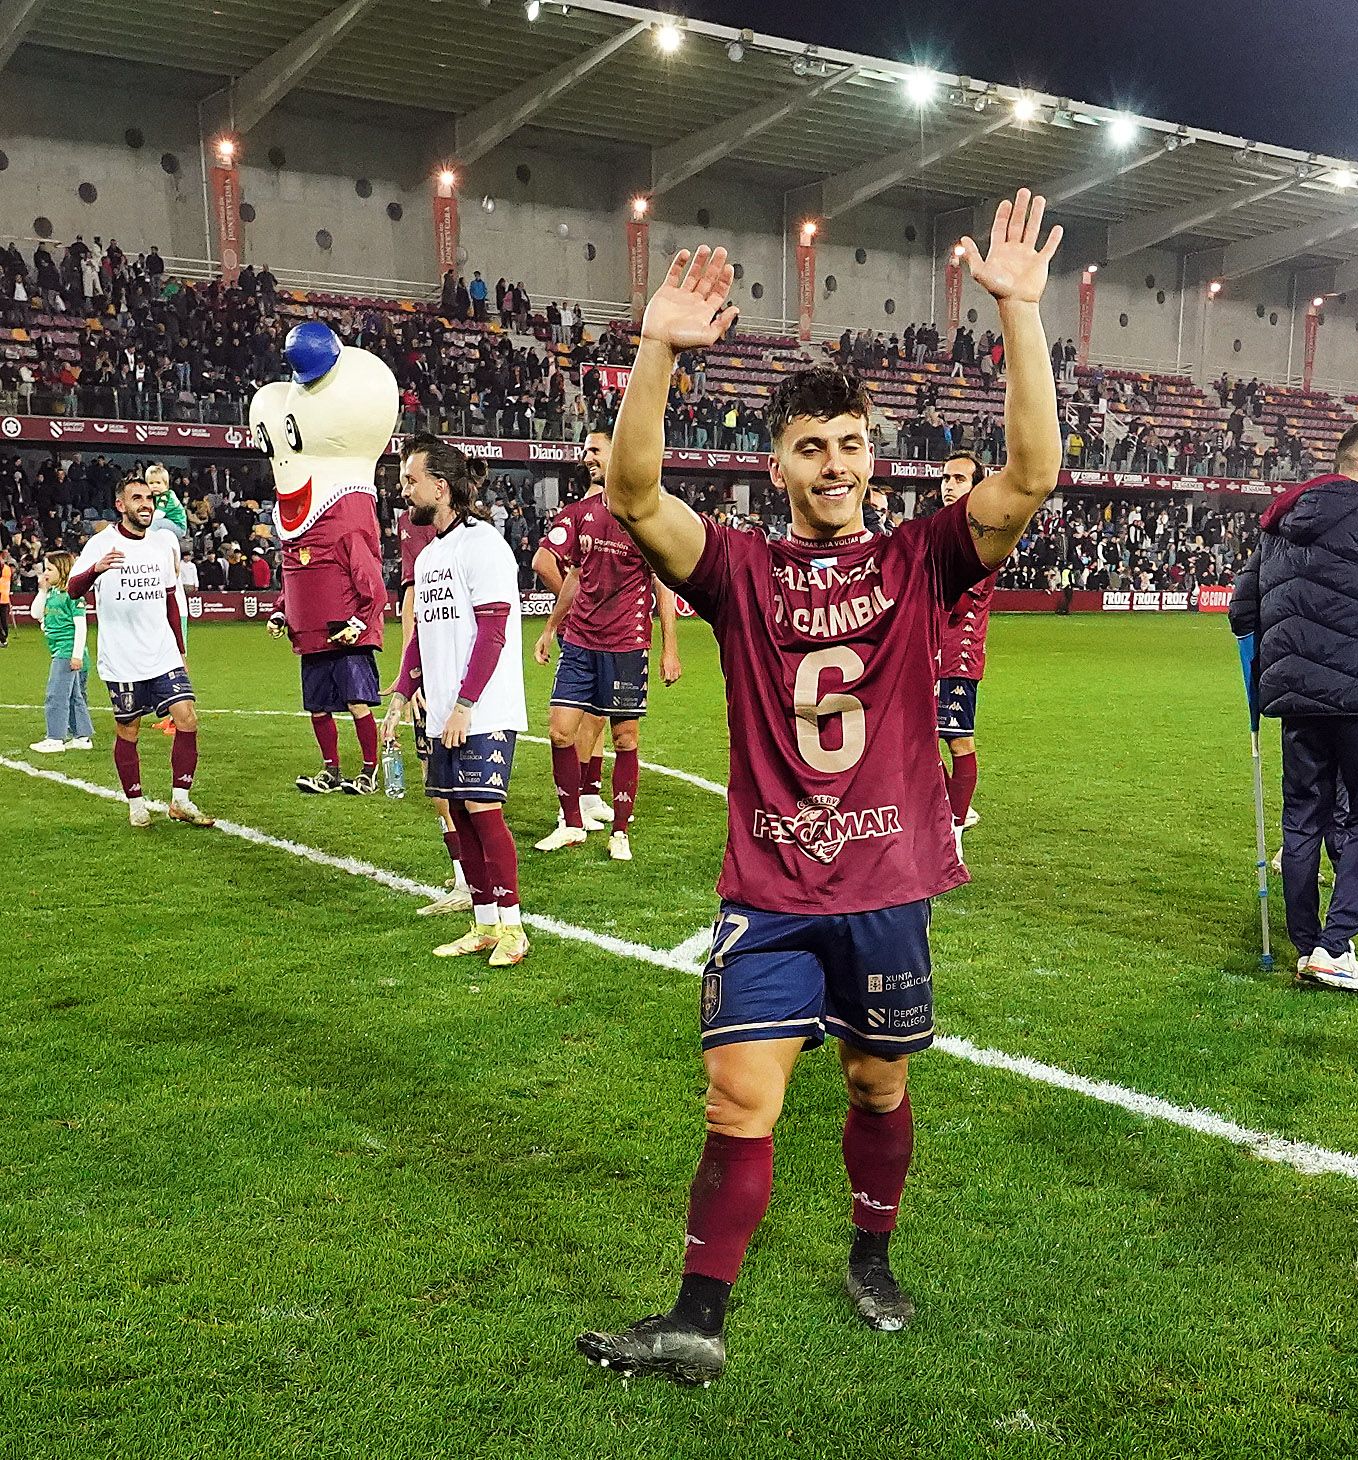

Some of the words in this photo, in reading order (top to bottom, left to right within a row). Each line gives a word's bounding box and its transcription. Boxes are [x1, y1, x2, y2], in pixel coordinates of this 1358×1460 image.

[529, 444, 563, 460] Diario
[120, 563, 161, 575] MUCHA
[116, 591, 126, 601] J.
[1102, 591, 1131, 605] FROIZ
[1133, 592, 1160, 605] FROIZ
[1161, 592, 1188, 605] FROIZ
[520, 600, 556, 615] ESCA
[792, 586, 895, 638] CAMBIL
[794, 645, 865, 774] 6
[753, 804, 904, 846] PESCAMAR
[885, 971, 913, 983] XUNTA
[885, 981, 897, 992] DE
[899, 976, 928, 991] GALICIA
[893, 1003, 929, 1019] DEPORTE
[893, 1014, 926, 1029] GALEGO
